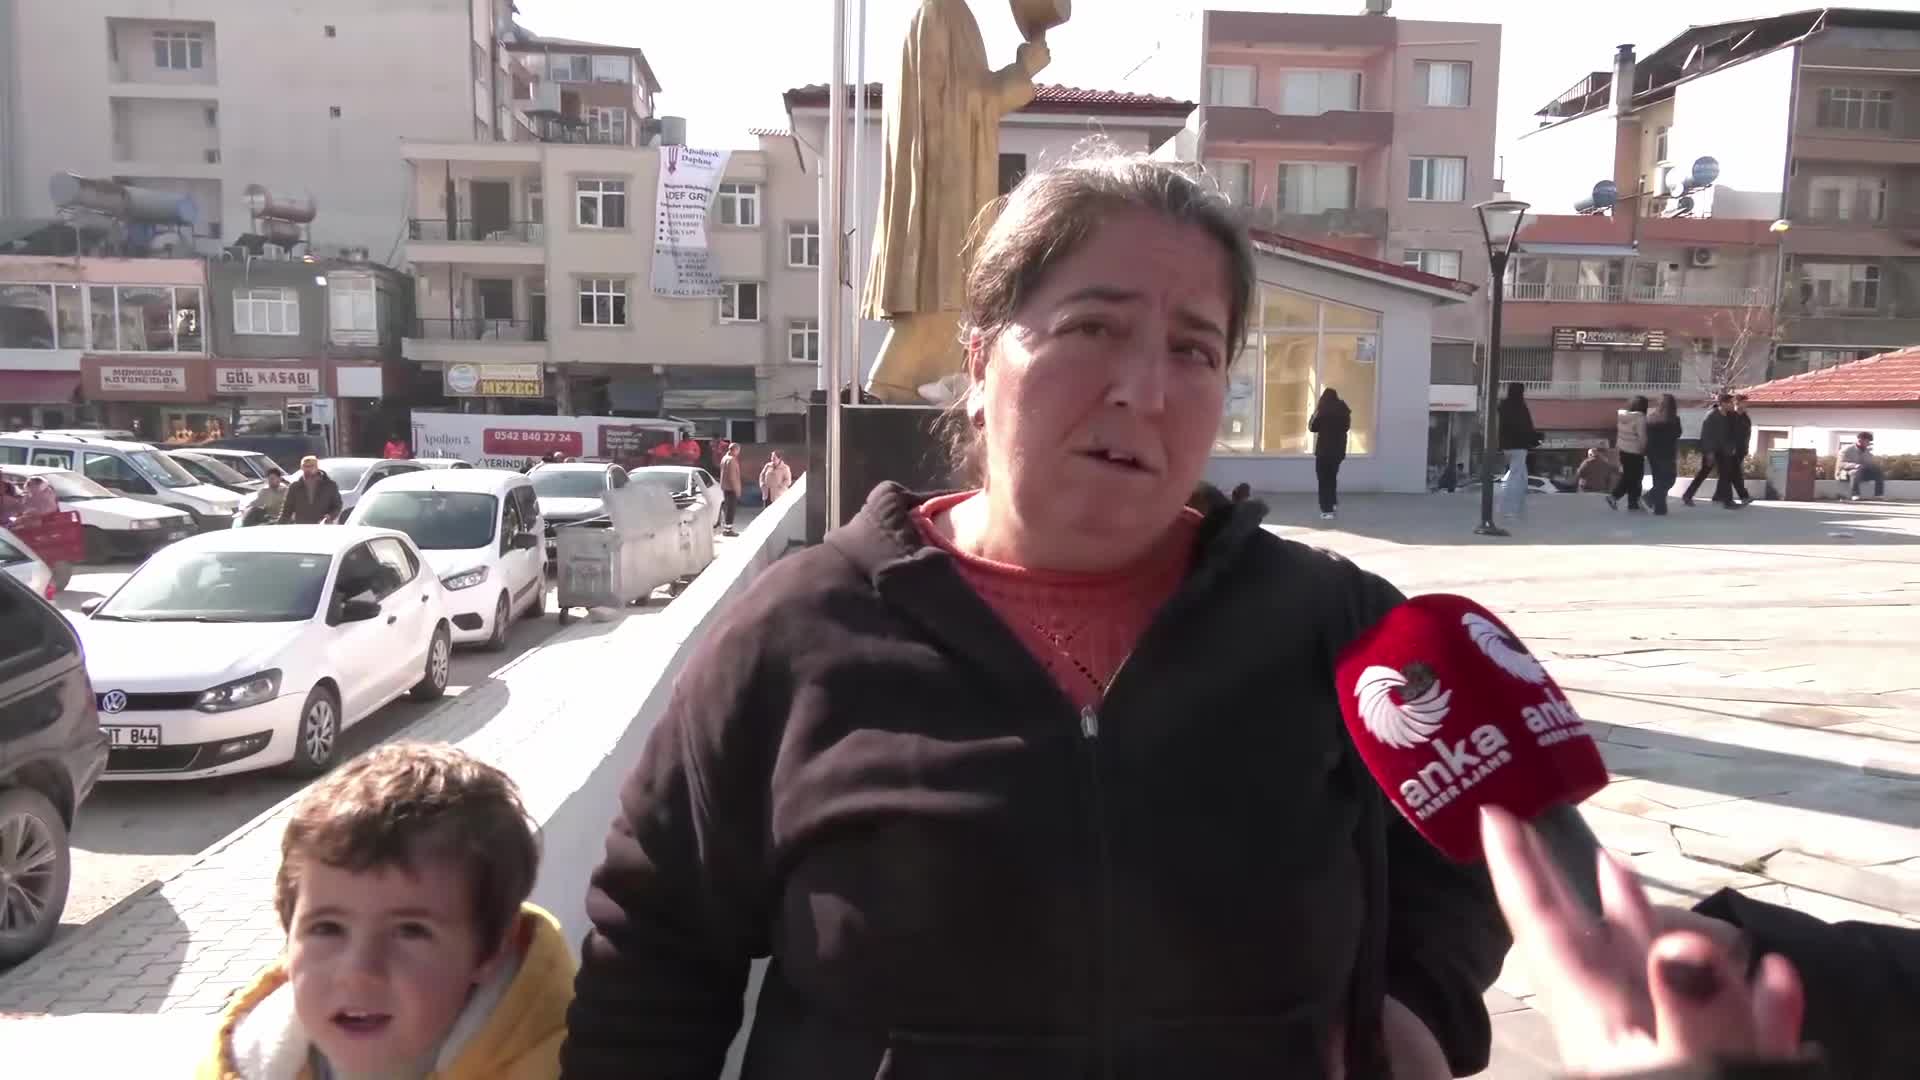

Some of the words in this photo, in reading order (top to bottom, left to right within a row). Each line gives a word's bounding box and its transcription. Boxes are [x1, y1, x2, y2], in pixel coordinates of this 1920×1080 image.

[494, 431, 519, 441] 0542
[521, 432, 541, 441] 840
[543, 432, 556, 441] 27
[558, 433, 571, 441] 24
[1520, 687, 1583, 733] ank
[130, 728, 157, 743] 844
[1399, 724, 1509, 808] anka
[1415, 785, 1461, 821] HABER
